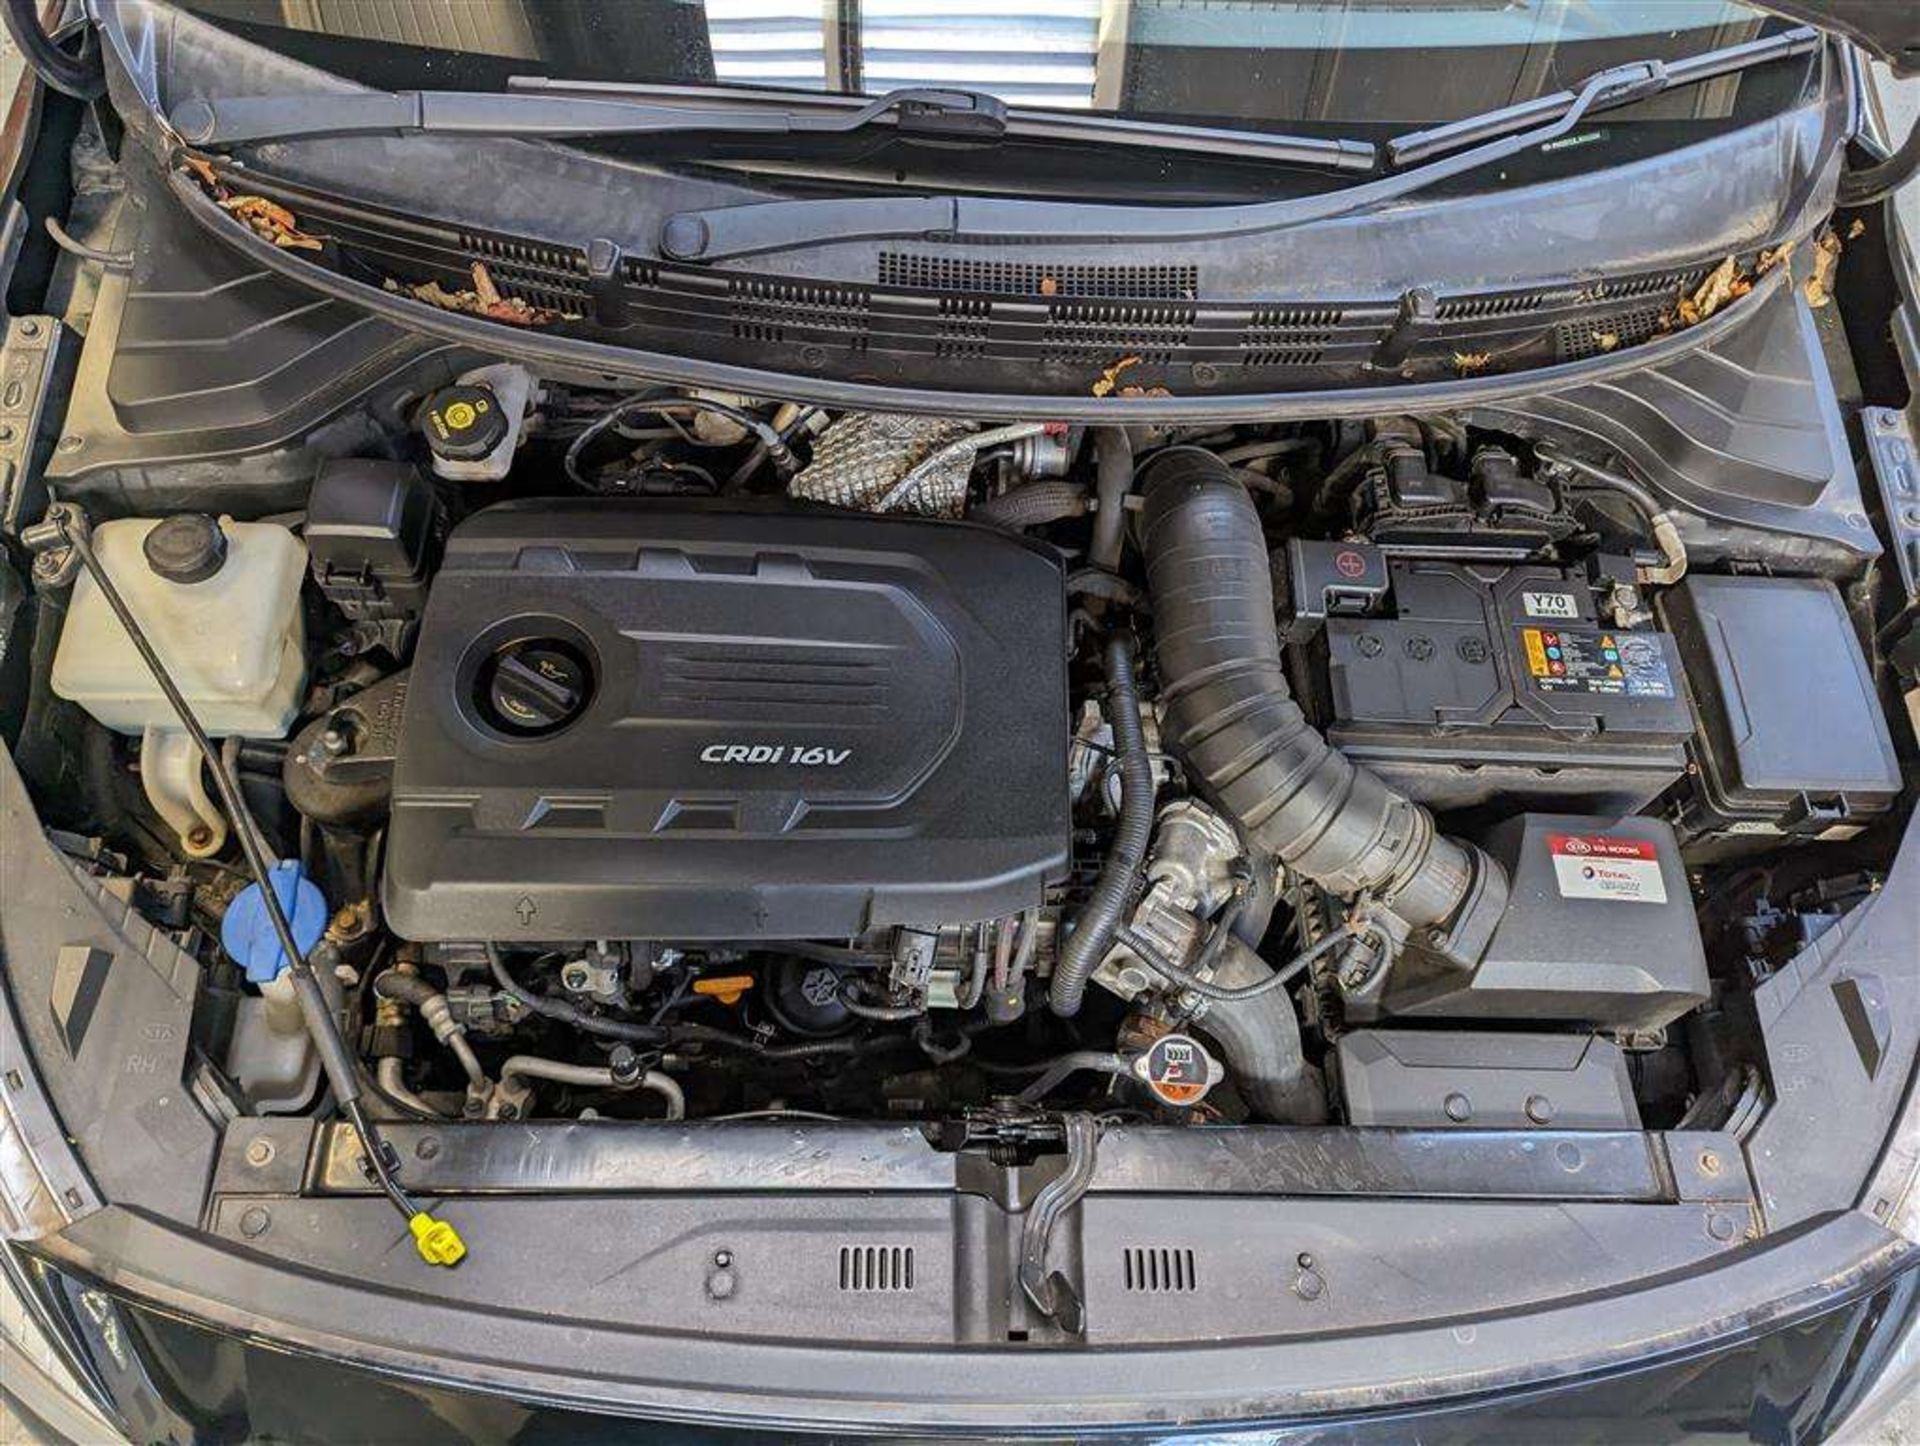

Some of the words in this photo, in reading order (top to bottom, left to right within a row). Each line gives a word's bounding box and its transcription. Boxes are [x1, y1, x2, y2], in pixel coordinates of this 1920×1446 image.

[1532, 594, 1566, 608] Y70
[790, 746, 852, 765] 16V
[1608, 846, 1640, 855] MOTORS
[126, 1053, 158, 1073] RH
